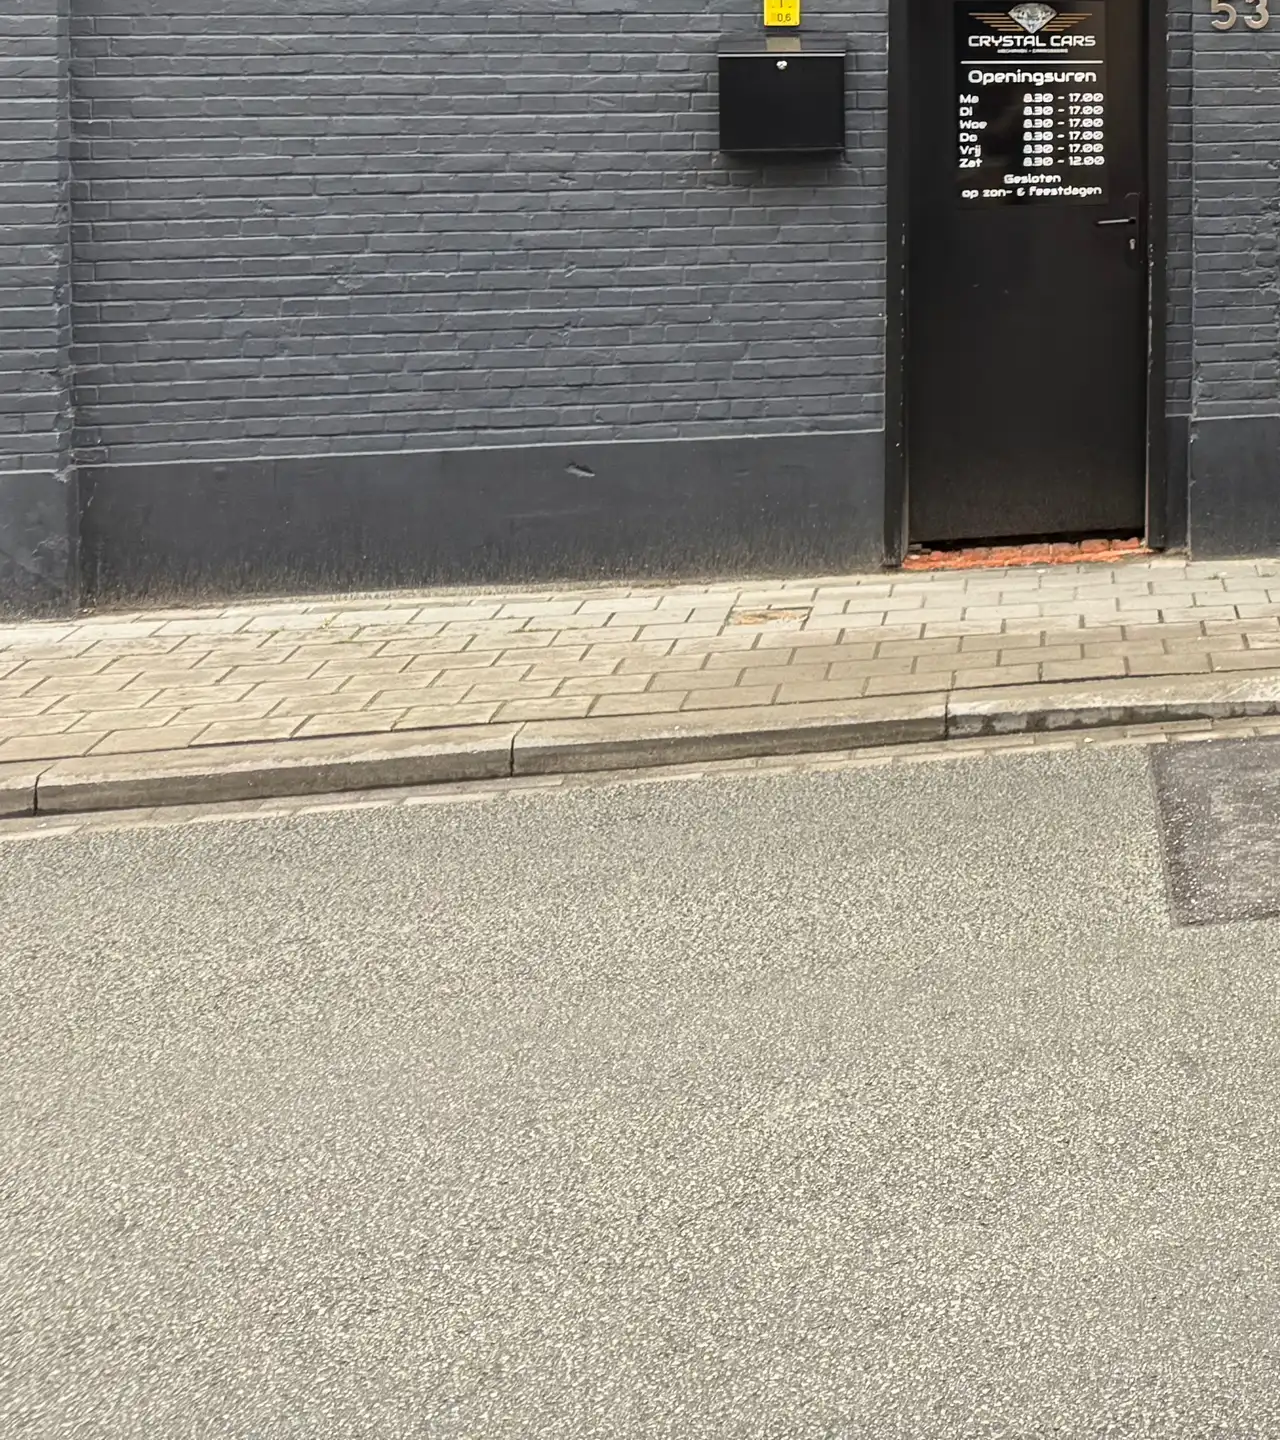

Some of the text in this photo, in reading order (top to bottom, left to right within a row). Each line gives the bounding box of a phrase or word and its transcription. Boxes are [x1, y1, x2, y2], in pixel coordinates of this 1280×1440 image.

[969, 36, 1096, 46] CRYSTAL CARS
[968, 69, 1096, 86] Openingsuren
[1023, 93, 1053, 103] 8.30
[1069, 93, 1103, 102] 17.00
[960, 107, 972, 116] Di
[1024, 106, 1053, 115] 8.30
[1069, 106, 1103, 115] 17.00
[1023, 119, 1053, 128] 8.30
[1069, 118, 1103, 127] 17.00
[1023, 131, 1053, 141] 8.30
[1069, 131, 1103, 140] 17.00
[960, 145, 981, 156] Vrij
[1023, 144, 1053, 153] 8.30
[1069, 143, 1103, 152] 17.00
[1023, 157, 1053, 166] 8.30
[1069, 156, 1104, 165] 12.00
[1004, 174, 1061, 184] Gesloten
[962, 186, 1102, 198] op zon- & feestdagen
